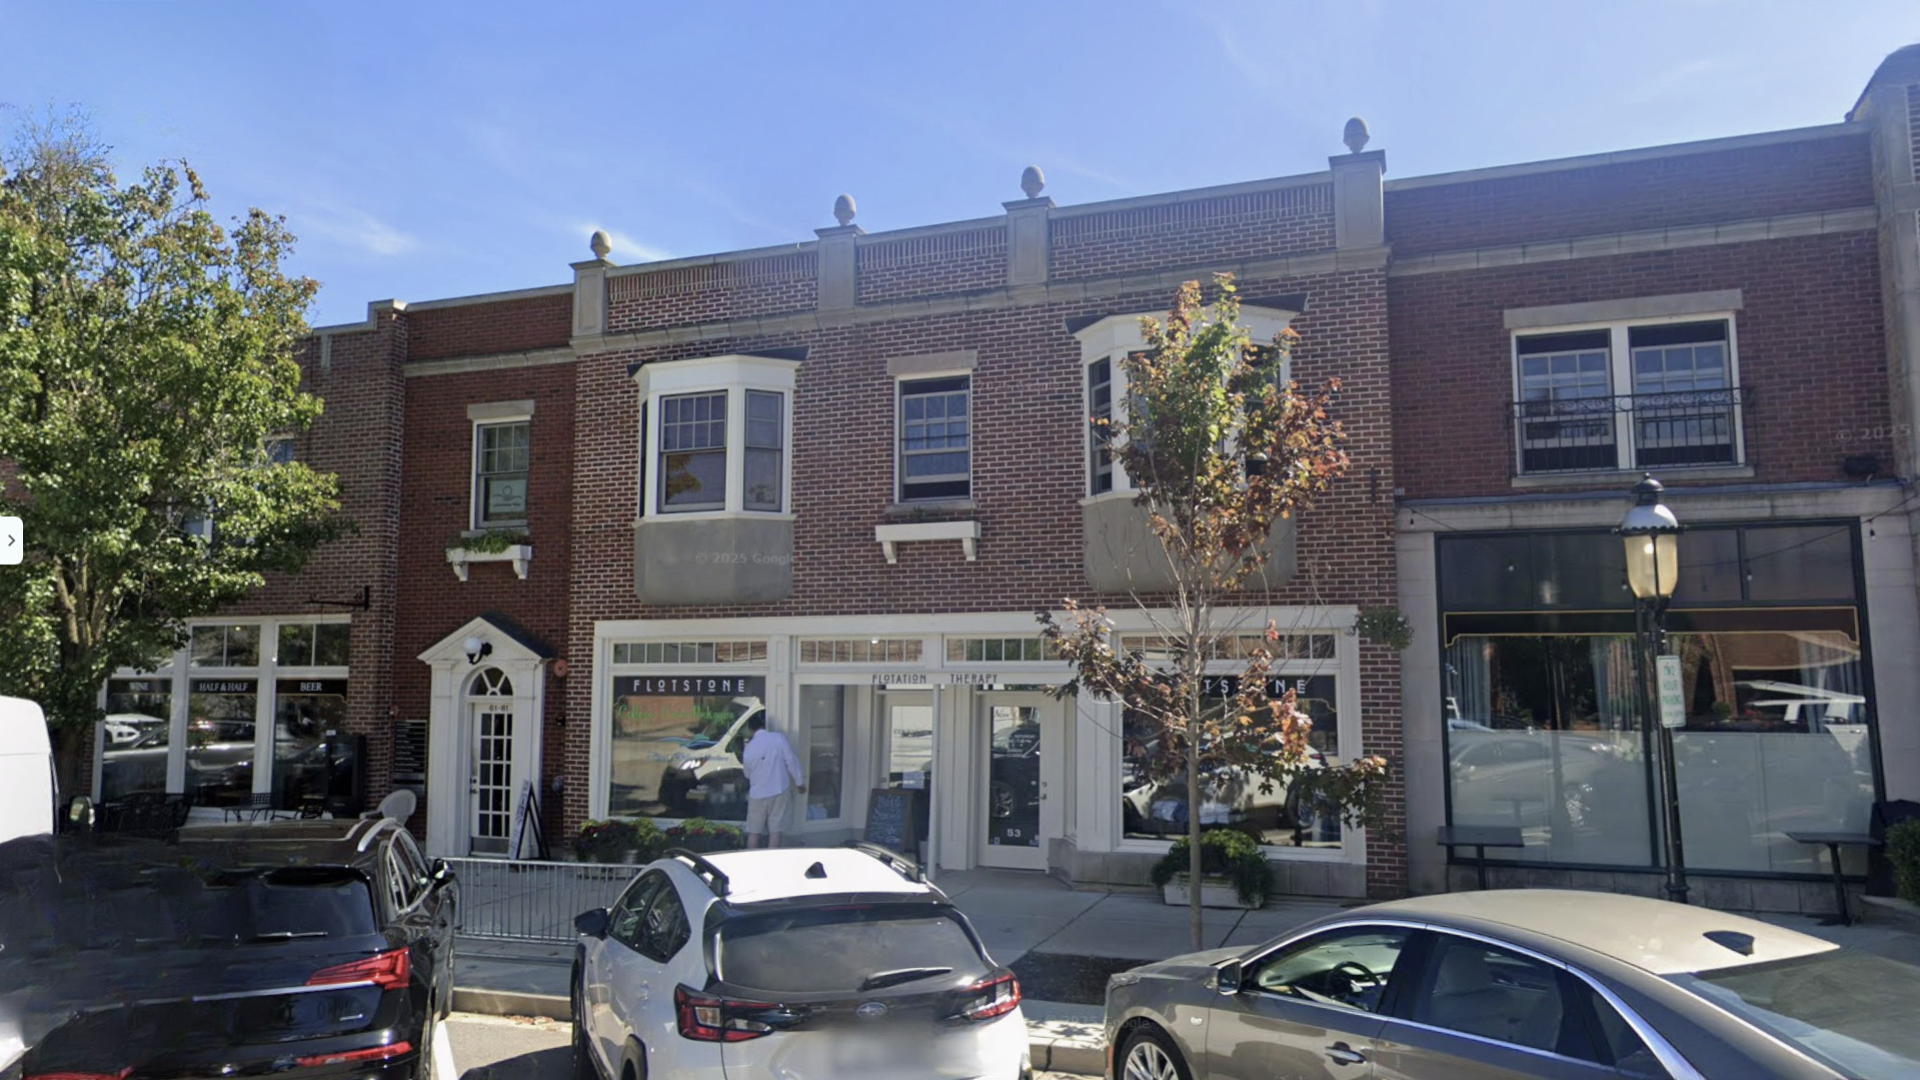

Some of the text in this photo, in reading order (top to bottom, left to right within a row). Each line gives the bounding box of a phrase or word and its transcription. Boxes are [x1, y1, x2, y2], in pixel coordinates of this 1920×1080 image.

[872, 674, 998, 684] FLOTATION THERAPY
[129, 682, 149, 691] WINE
[199, 682, 249, 692] HALF & HALF
[299, 682, 323, 692] BEER
[633, 679, 745, 692] FLOTSTONE
[1006, 828, 1021, 838] 53
